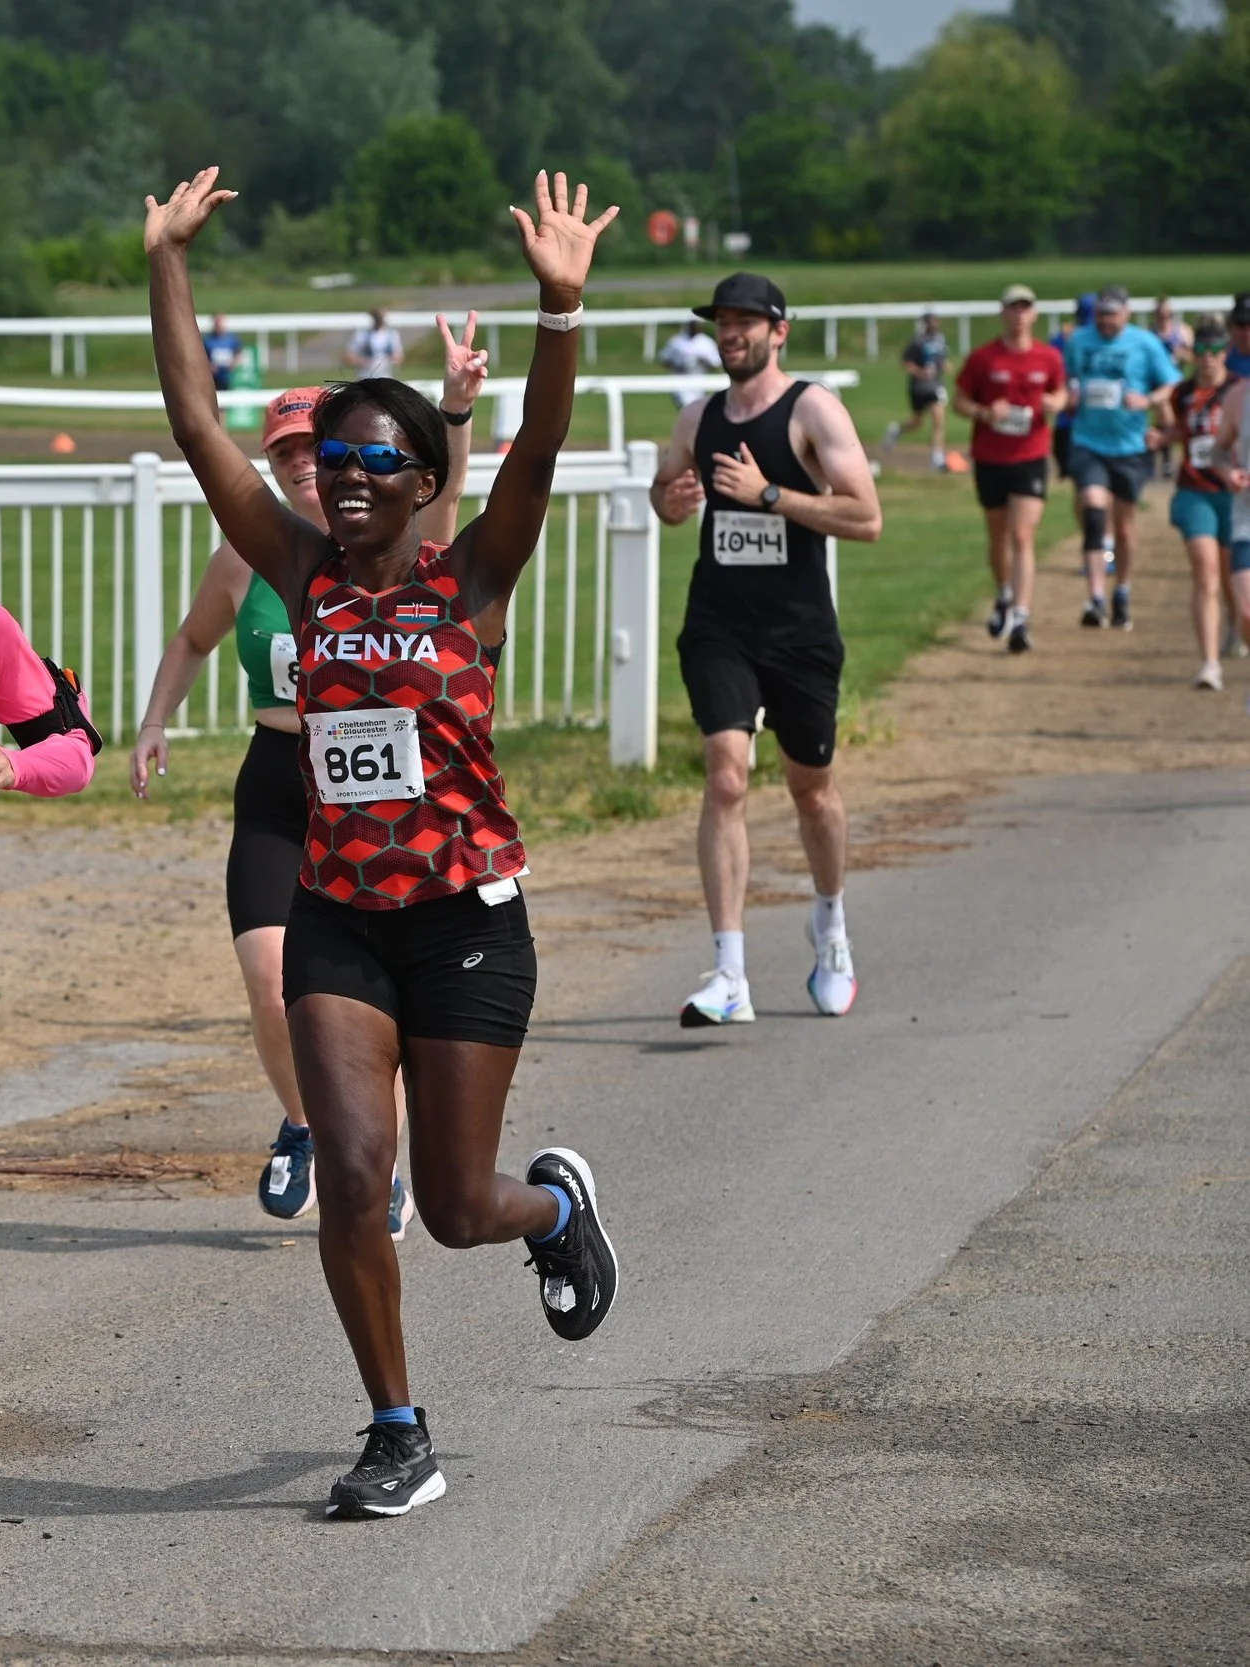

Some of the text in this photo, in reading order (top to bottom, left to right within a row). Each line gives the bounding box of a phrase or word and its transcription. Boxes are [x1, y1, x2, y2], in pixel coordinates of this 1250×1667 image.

[717, 529, 783, 554] 1044
[314, 633, 439, 662] KENYA
[338, 719, 387, 730] Cheltenham
[343, 726, 387, 736] Gloucester
[324, 742, 402, 784] 861
